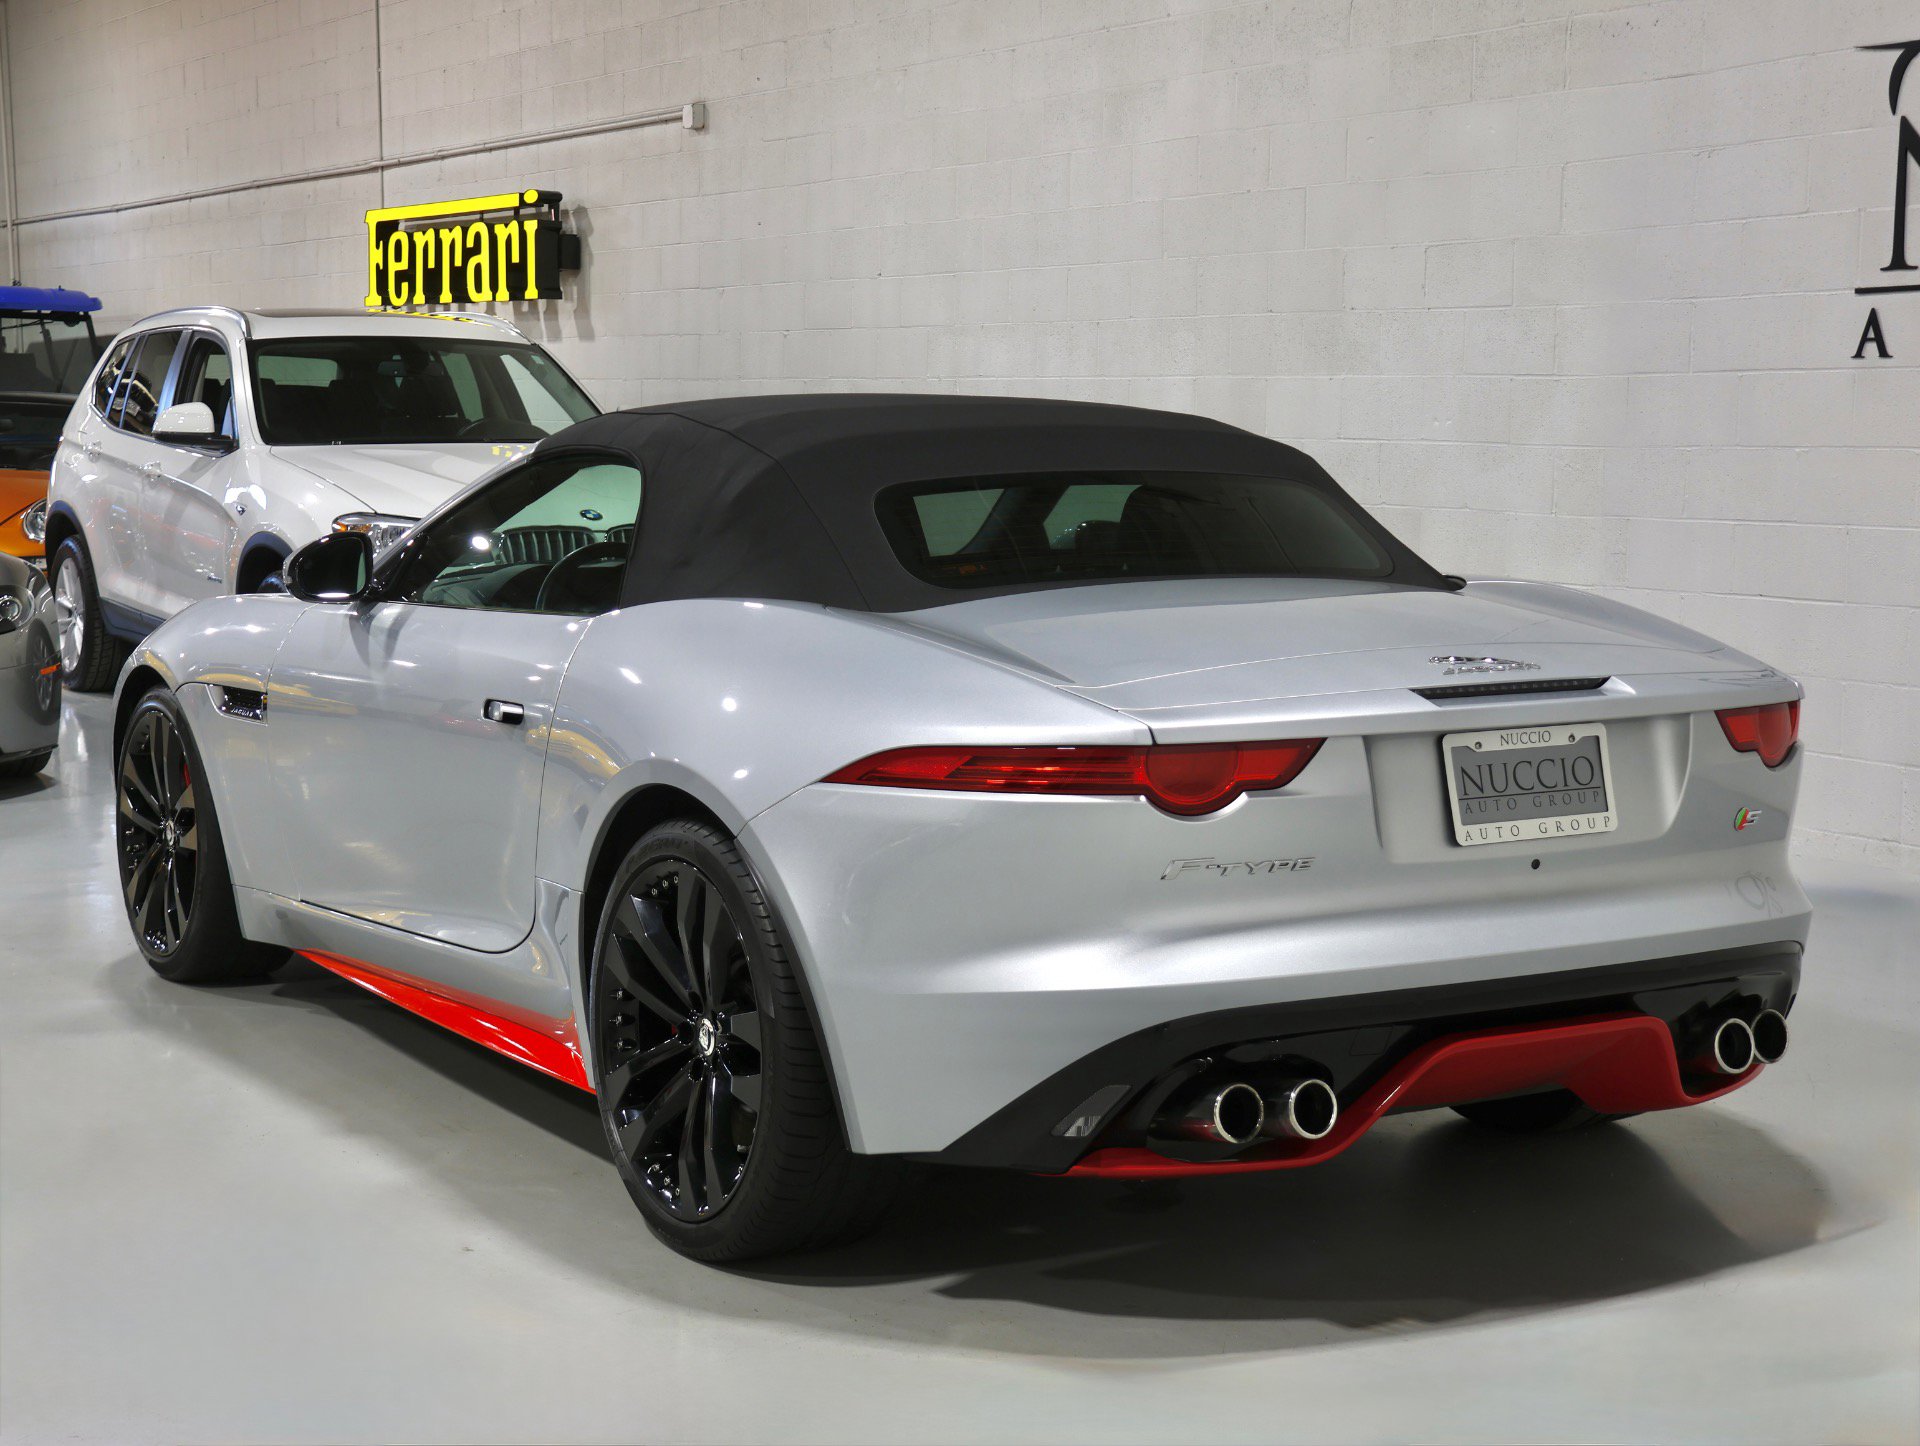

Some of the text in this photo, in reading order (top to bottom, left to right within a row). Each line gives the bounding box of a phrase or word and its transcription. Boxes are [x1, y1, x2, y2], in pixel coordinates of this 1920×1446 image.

[364, 189, 539, 307] Ferrari
[1500, 730, 1551, 746] NUCCIO
[1460, 755, 1595, 796] NUCCIO
[1465, 790, 1600, 815] AUTO GROUP
[1464, 815, 1610, 842] AUTO GROUP
[1160, 857, 1316, 880] F-TYPE
